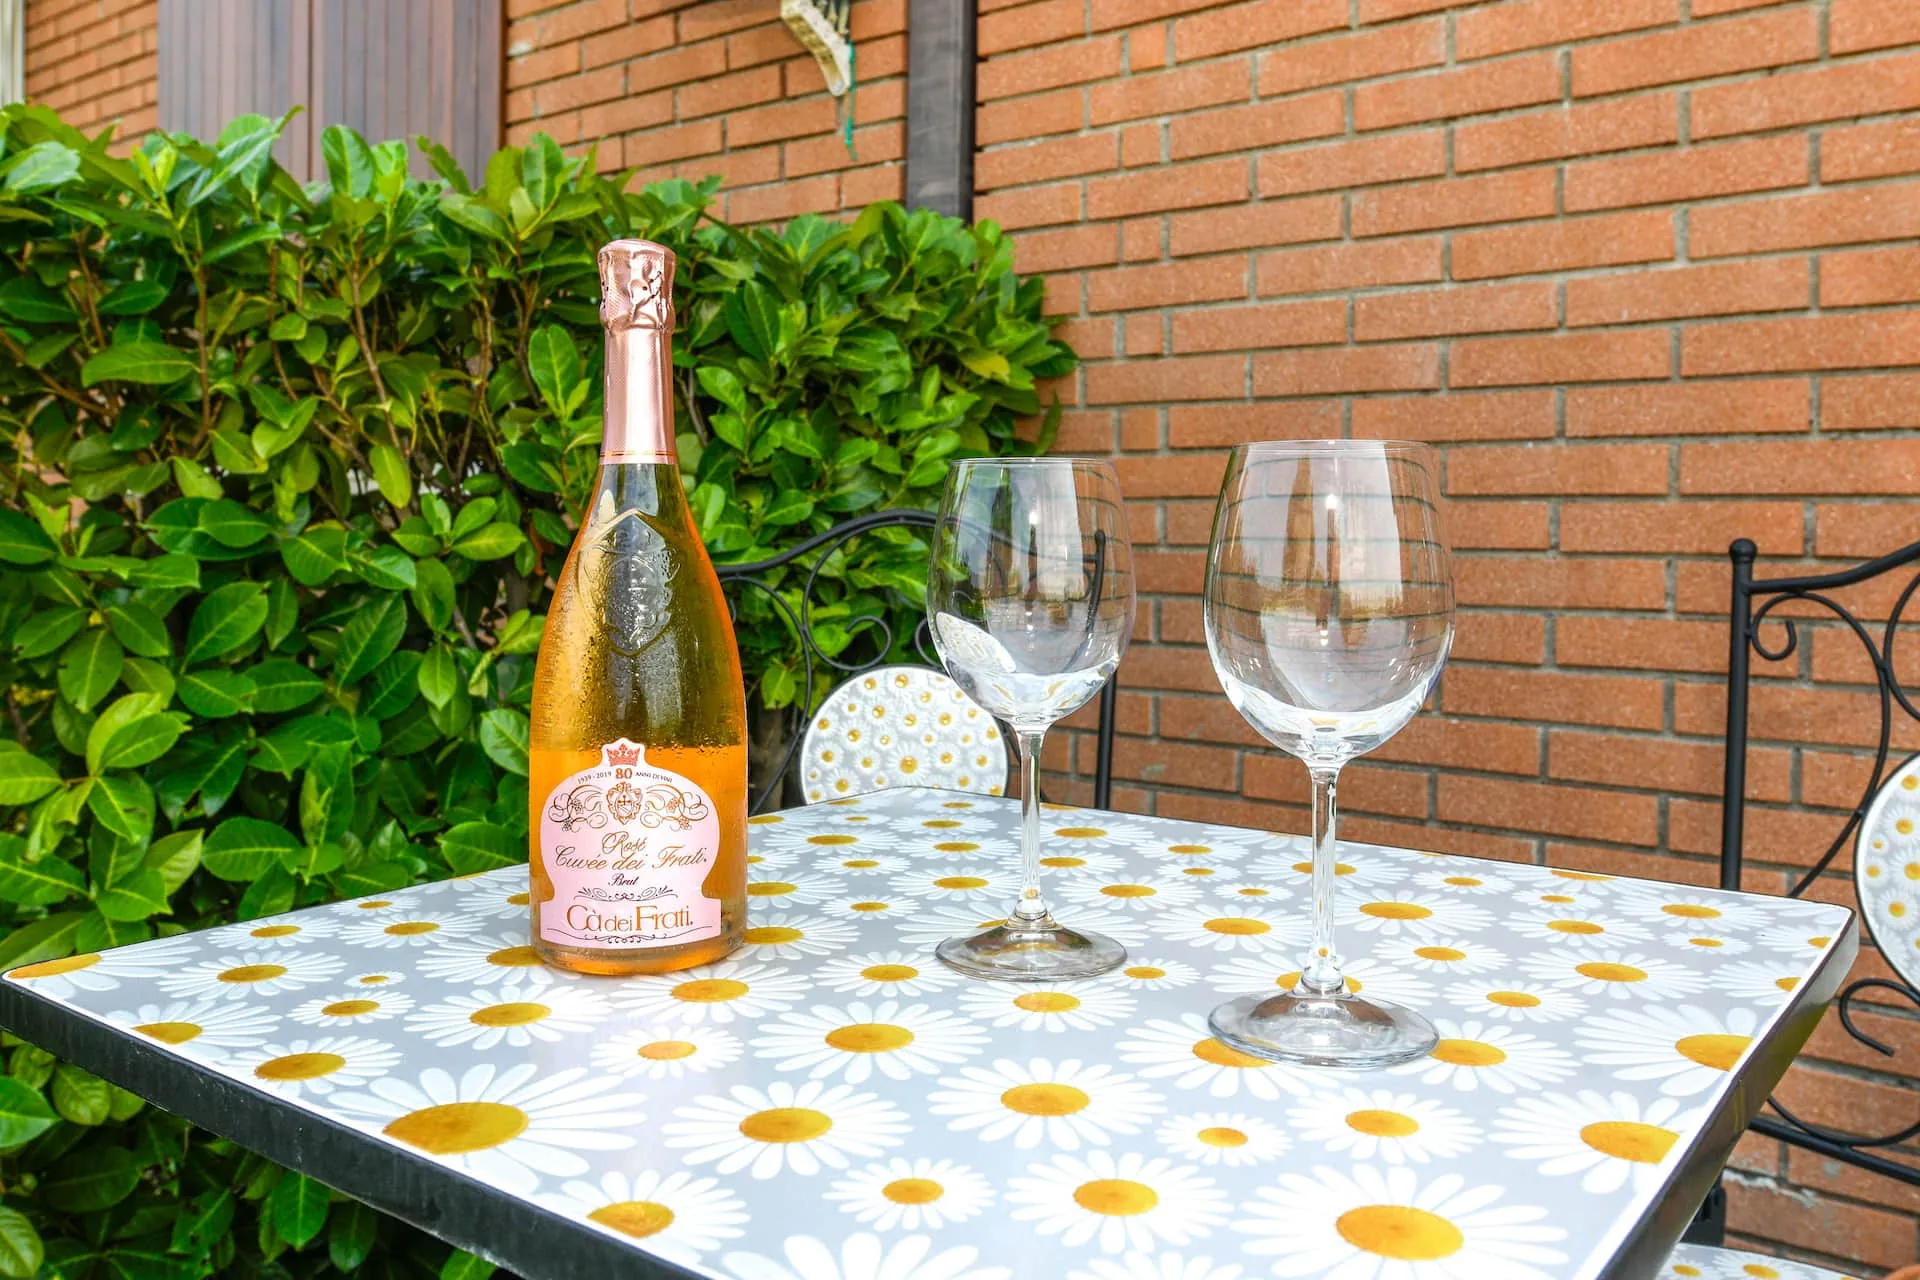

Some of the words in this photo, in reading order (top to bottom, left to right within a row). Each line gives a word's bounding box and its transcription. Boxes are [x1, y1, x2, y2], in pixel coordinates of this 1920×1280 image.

[615, 767, 633, 779] 80
[602, 830, 647, 858] Rosé
[555, 845, 608, 870] Cuvée
[611, 851, 649, 871] dei
[608, 873, 640, 887] Brut
[566, 904, 602, 932] Cà
[604, 915, 633, 932] dei
